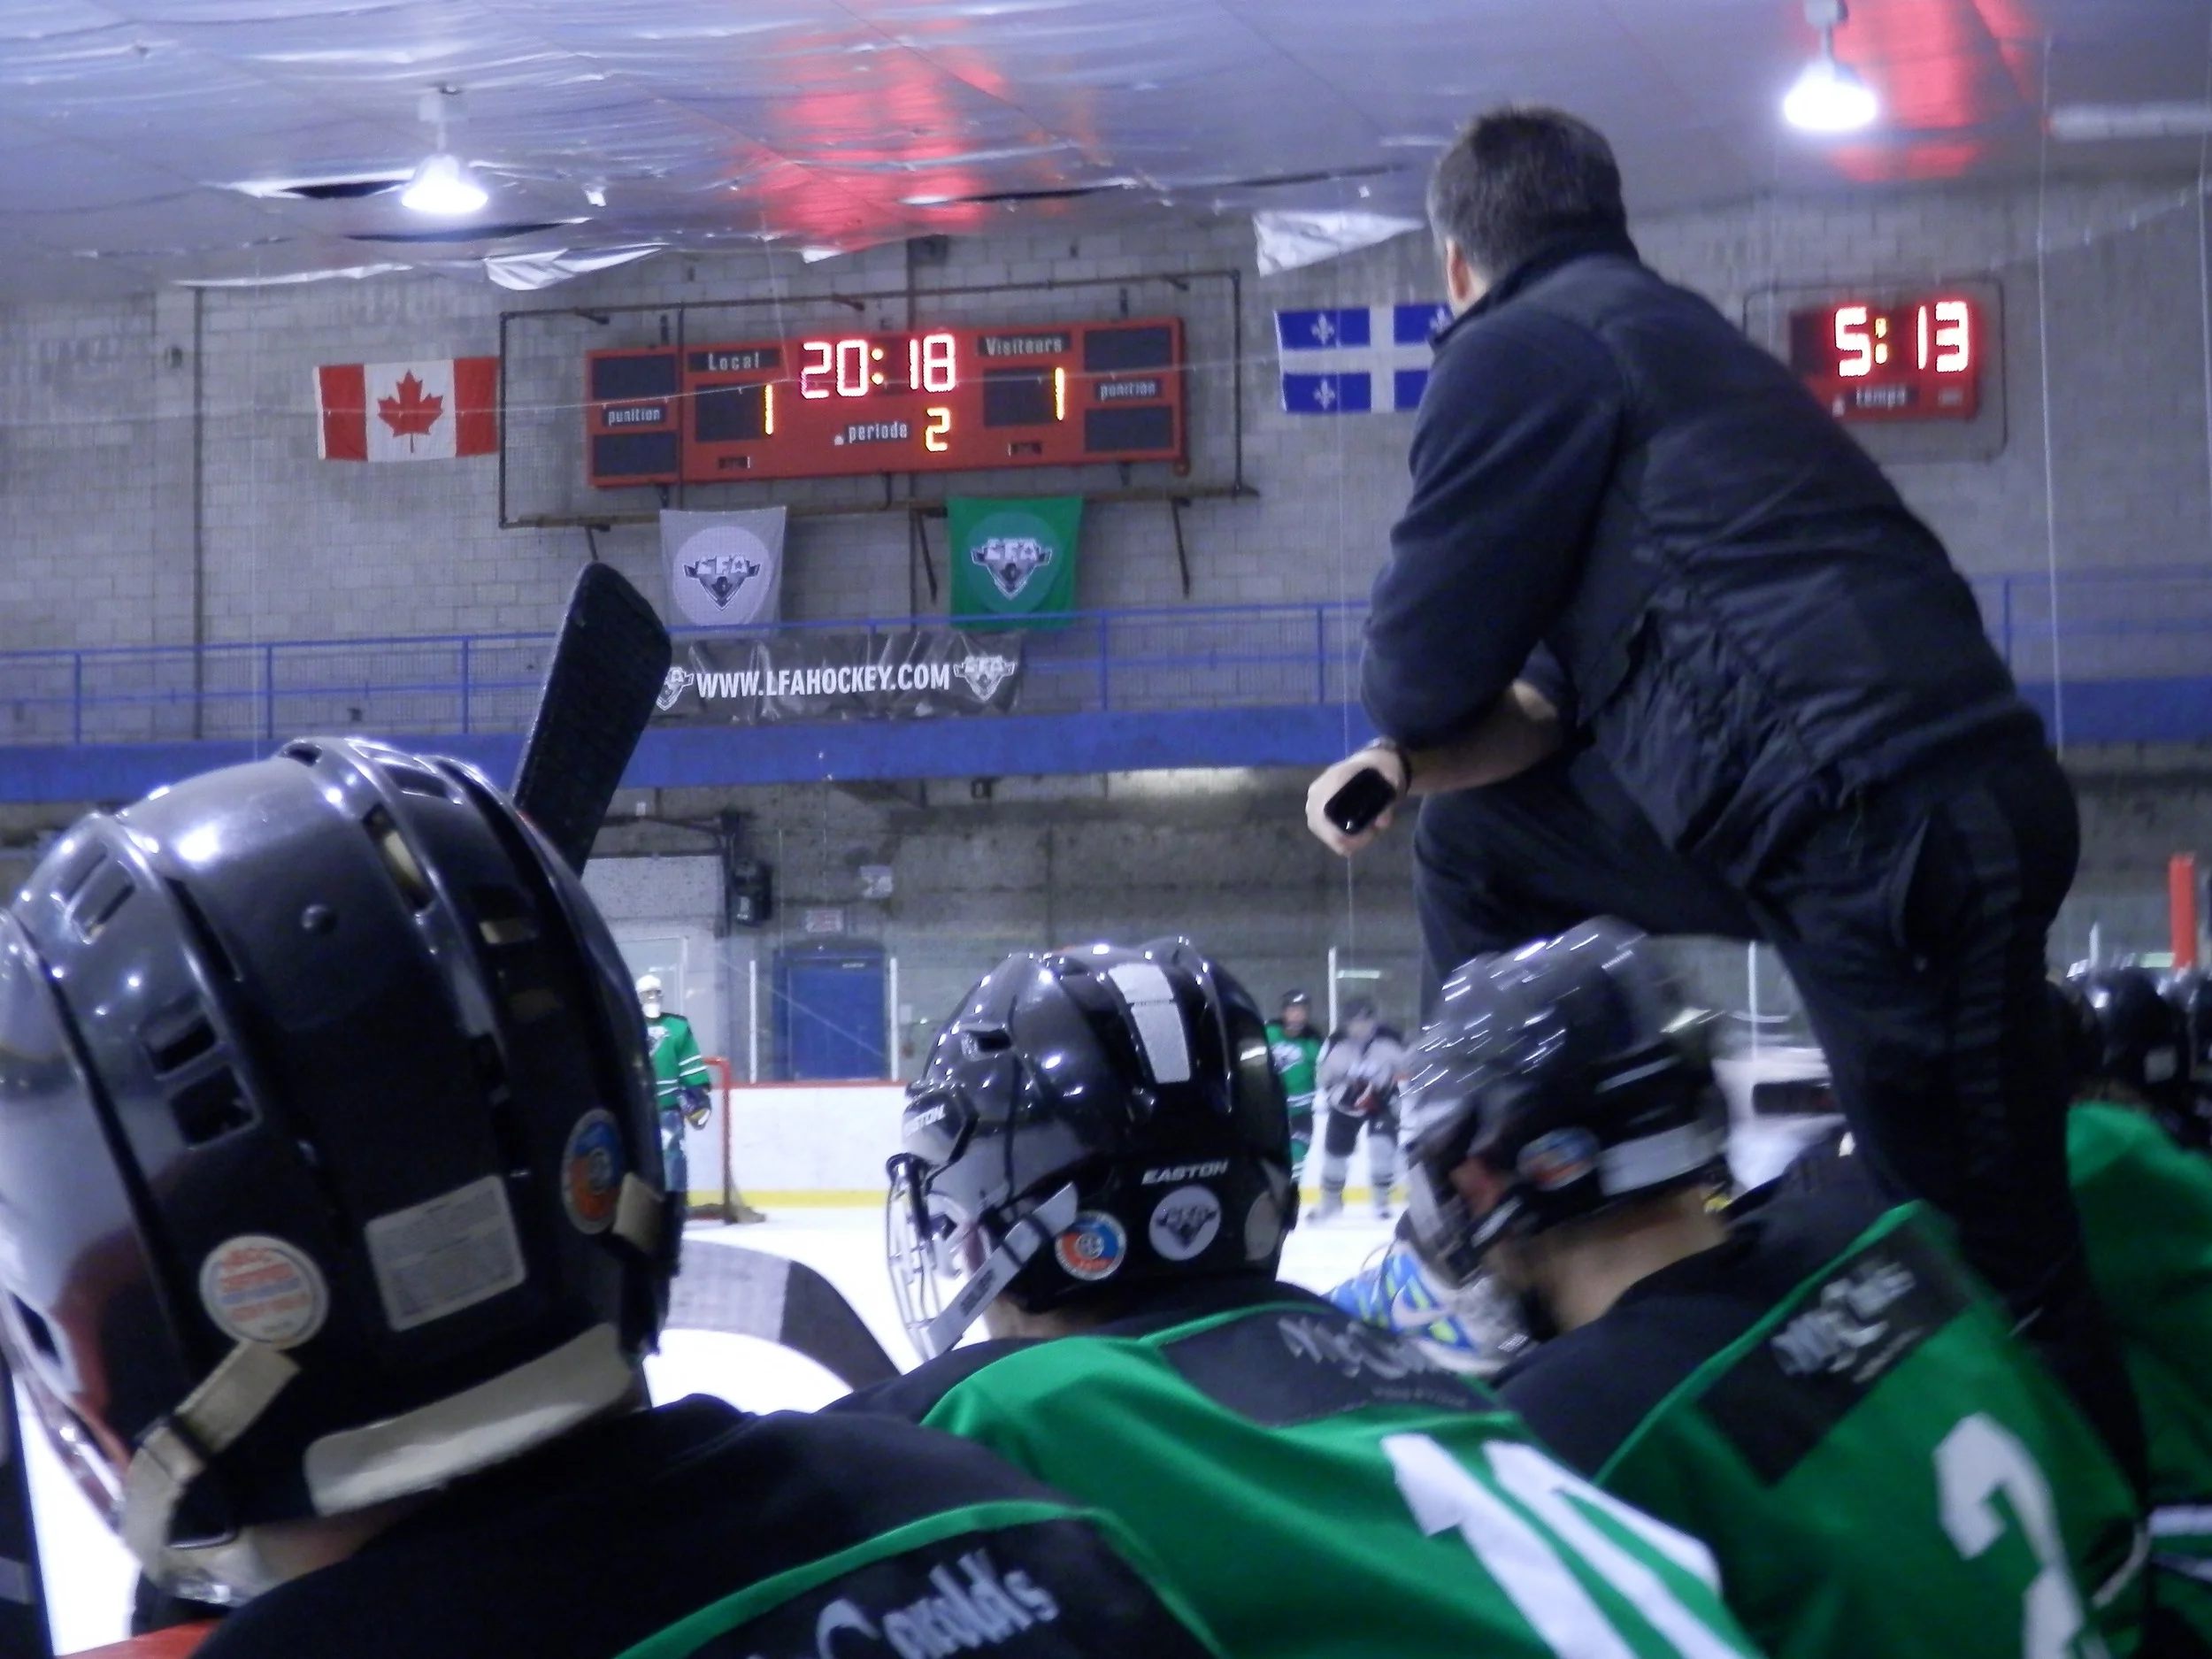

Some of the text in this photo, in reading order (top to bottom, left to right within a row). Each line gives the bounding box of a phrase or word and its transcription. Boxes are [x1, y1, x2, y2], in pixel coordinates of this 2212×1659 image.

[1834, 301, 1969, 377] 5:13
[709, 352, 759, 371] Local
[801, 334, 957, 399] 20:18
[608, 407, 661, 426] punition
[926, 407, 950, 452] 2
[695, 664, 950, 698] WWW.LFAHOCKEY.COM
